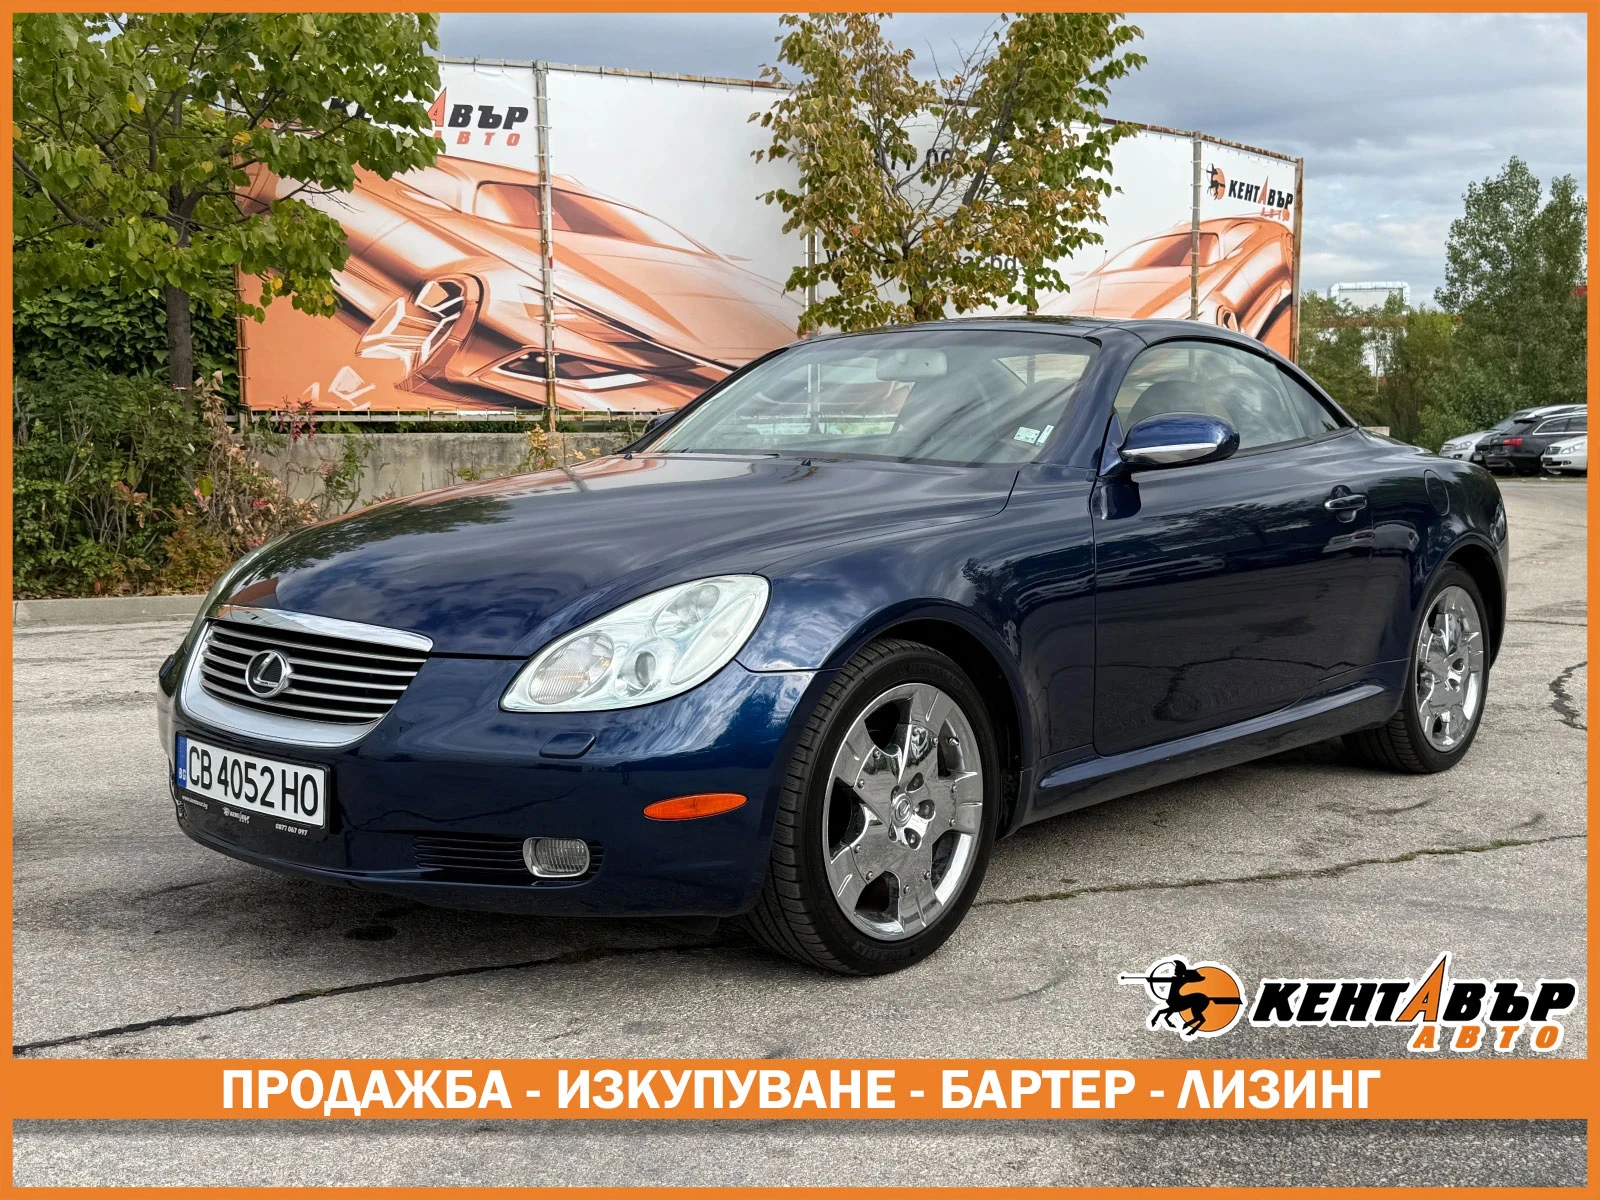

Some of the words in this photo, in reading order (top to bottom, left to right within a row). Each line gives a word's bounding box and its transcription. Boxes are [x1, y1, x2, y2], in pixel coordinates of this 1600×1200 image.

[1228, 176, 1294, 209] КЕНТАВЪР
[178, 767, 187, 781] BG
[217, 755, 276, 809] 4052
